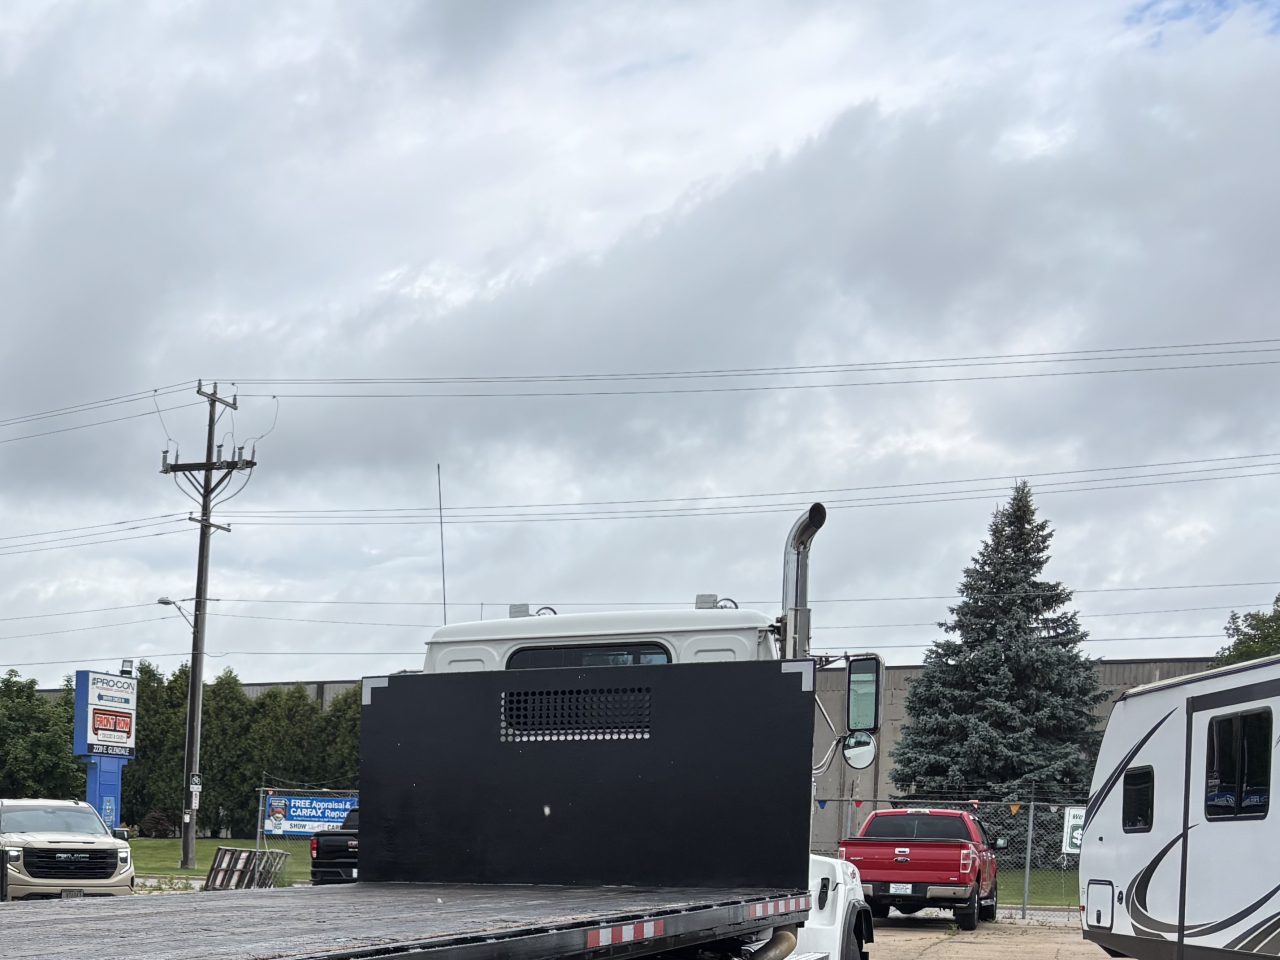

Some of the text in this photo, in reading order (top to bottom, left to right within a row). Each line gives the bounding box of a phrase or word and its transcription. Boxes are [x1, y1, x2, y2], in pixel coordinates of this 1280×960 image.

[95, 715, 130, 731] FRONT ROW
[108, 746, 130, 755] GLENDALE
[290, 799, 311, 807] FREE
[311, 800, 345, 811] Appraisal
[345, 801, 351, 809] &
[290, 808, 349, 819] CARFAX Repor
[289, 822, 307, 830] SHOW
[55, 853, 90, 861] GMC
